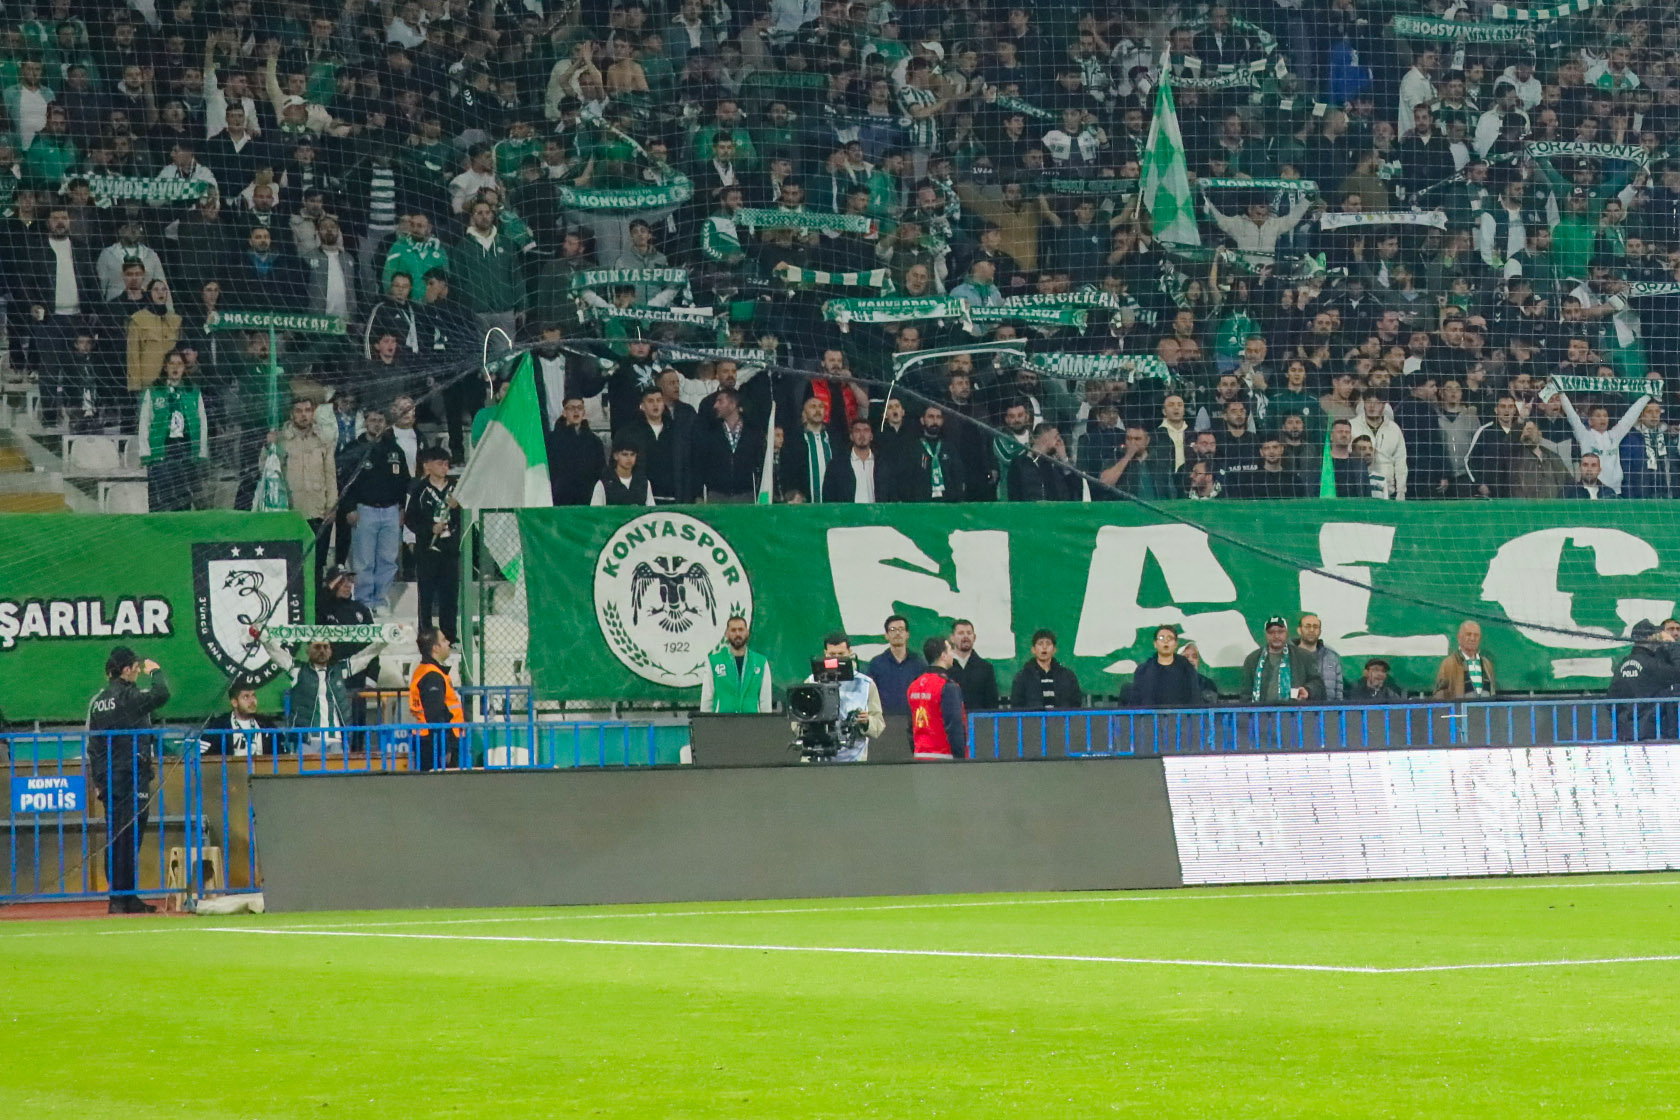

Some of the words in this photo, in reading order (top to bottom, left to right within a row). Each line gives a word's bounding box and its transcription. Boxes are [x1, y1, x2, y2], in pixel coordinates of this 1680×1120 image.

[1528, 141, 1584, 158] FORZA
[1590, 142, 1648, 167] KONYA
[579, 192, 668, 207] KONYASPOR
[586, 269, 687, 286] KONYASPOR
[1562, 374, 1647, 393] KONYASPOR
[602, 520, 740, 587] KONYASPOR
[266, 625, 383, 640] KONYASPOR
[663, 641, 690, 654] 1922
[246, 675, 261, 684] US
[28, 778, 69, 790] KONYA
[20, 791, 77, 812] POLİS
